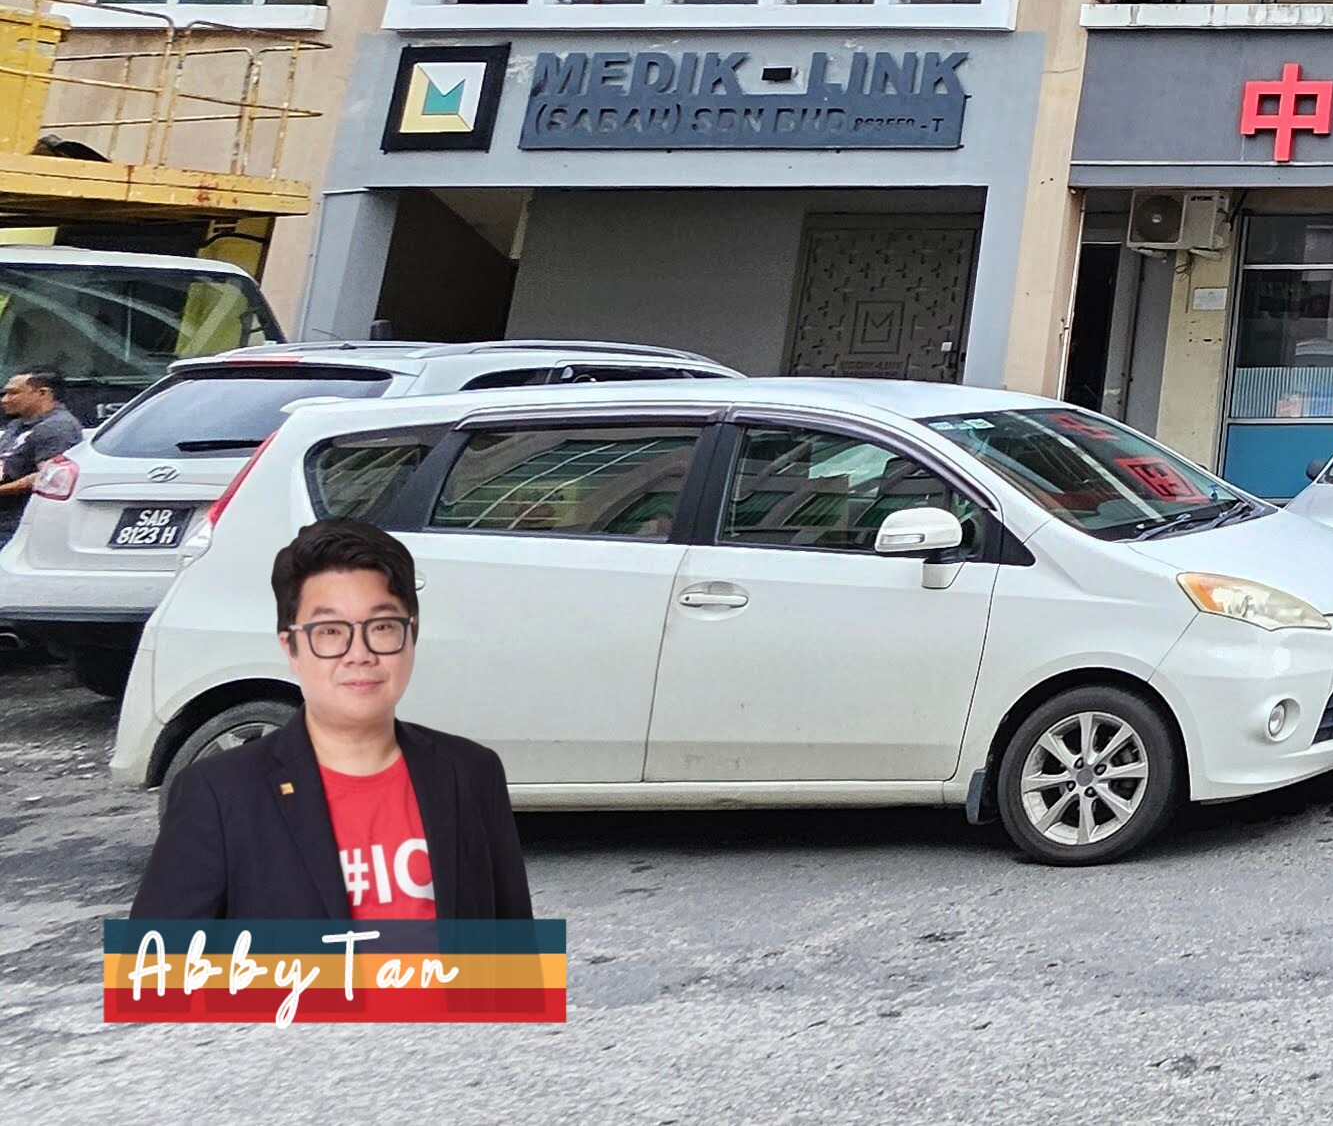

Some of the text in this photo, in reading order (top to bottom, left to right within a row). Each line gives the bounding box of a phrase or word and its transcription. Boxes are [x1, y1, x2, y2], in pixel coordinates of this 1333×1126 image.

[138, 509, 173, 526] SAB
[117, 527, 177, 545] 8123 H
